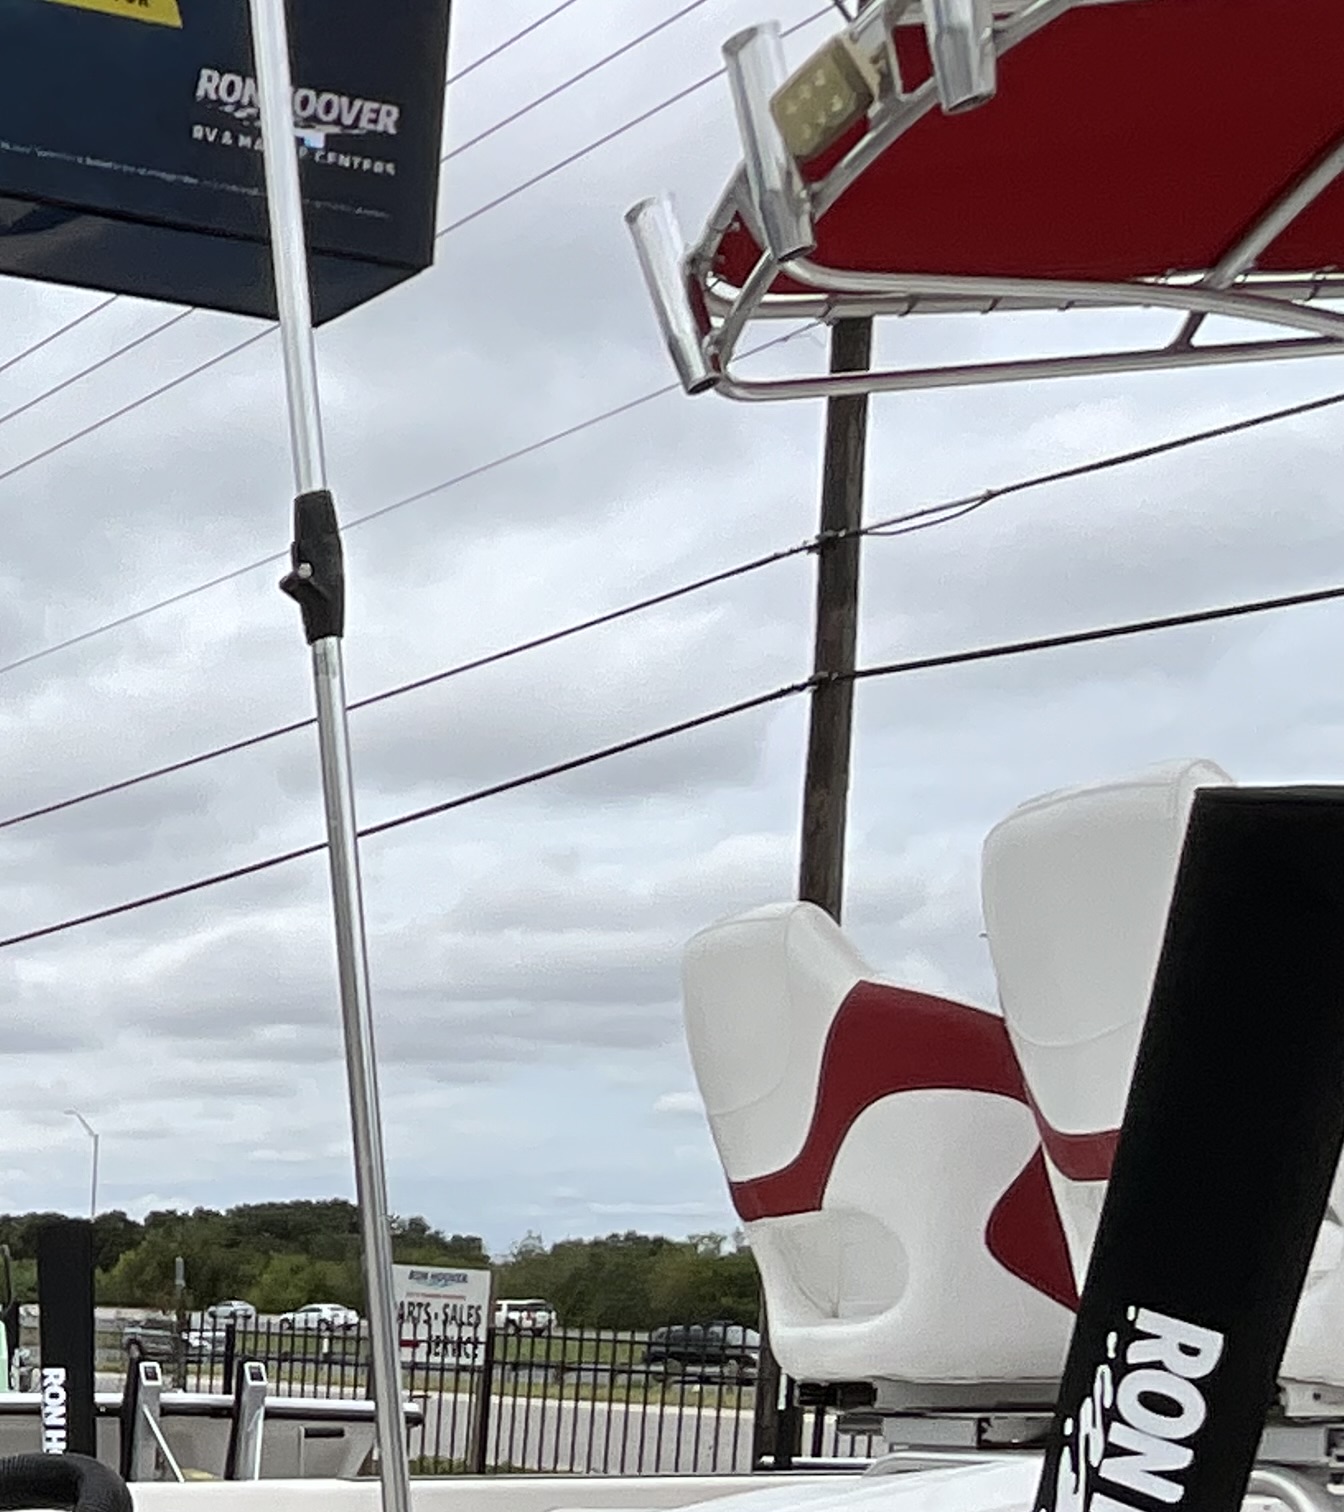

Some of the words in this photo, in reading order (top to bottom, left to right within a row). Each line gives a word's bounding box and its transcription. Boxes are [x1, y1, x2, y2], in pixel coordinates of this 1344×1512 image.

[293, 87, 400, 134] OOVER
[395, 1300, 432, 1325] ARTS
[41, 1367, 67, 1426] RON
[1098, 1307, 1225, 1504] RON
